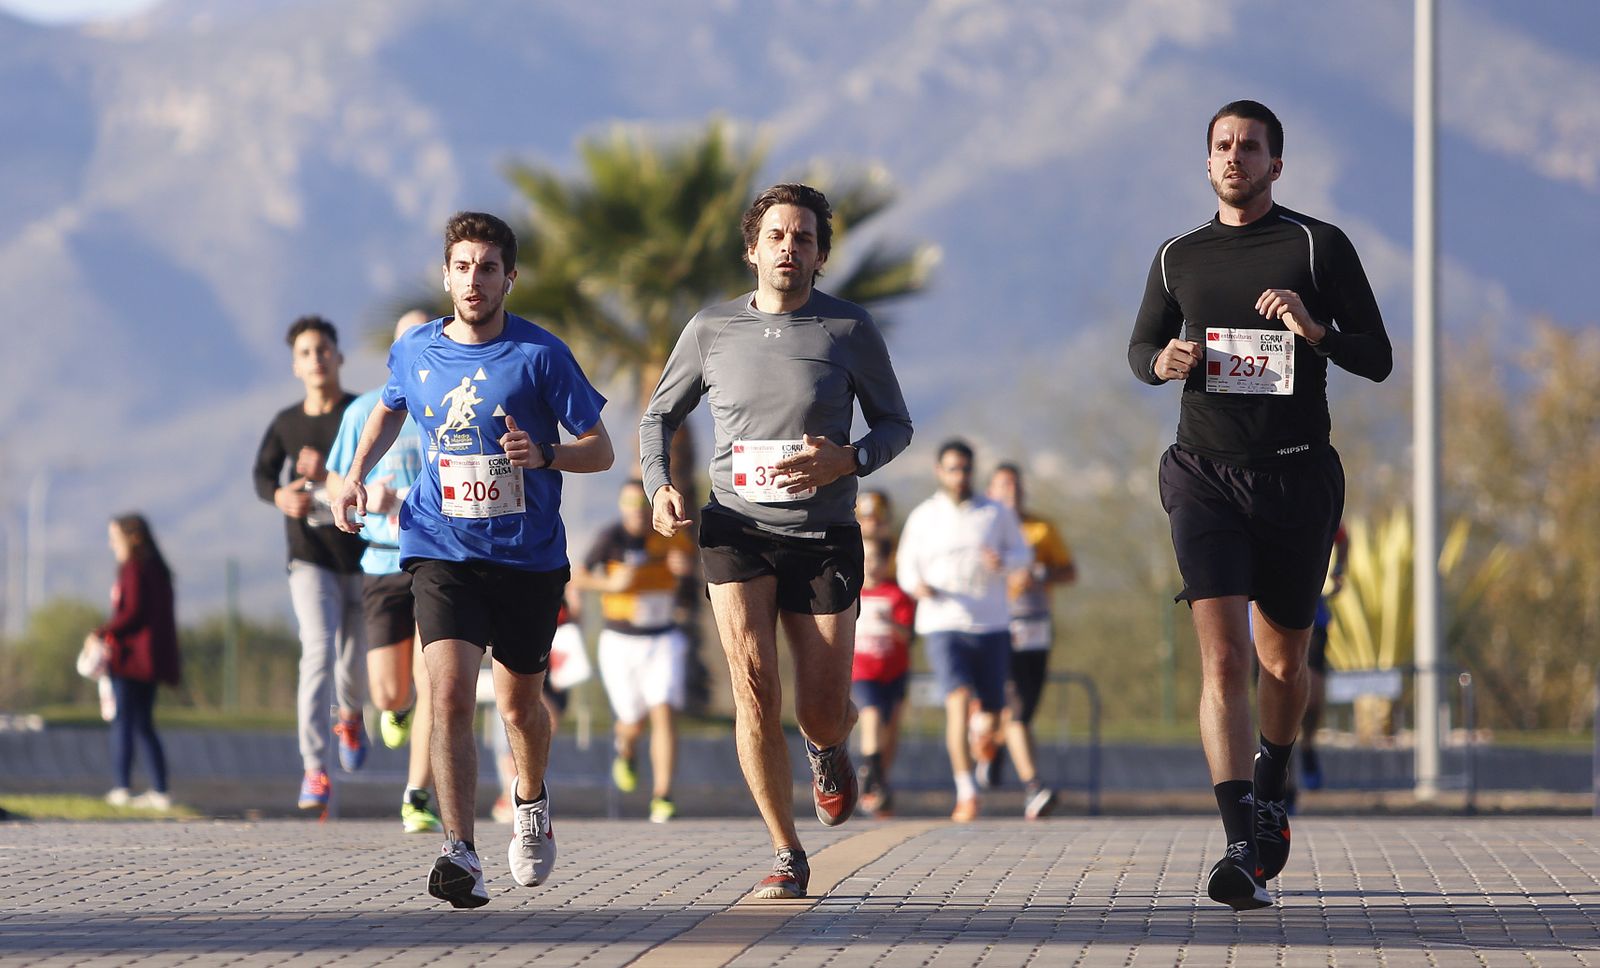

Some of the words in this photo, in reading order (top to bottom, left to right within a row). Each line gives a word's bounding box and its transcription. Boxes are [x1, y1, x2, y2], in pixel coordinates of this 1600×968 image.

[1220, 332, 1252, 340] entreculturas
[1260, 334, 1283, 343] CORRE
[1260, 343, 1283, 352] CAUSA
[1229, 355, 1269, 377] 237
[442, 434, 450, 446] 3
[782, 444, 804, 452] CORRE
[489, 467, 512, 476] CAUSA
[462, 481, 500, 502] 206
